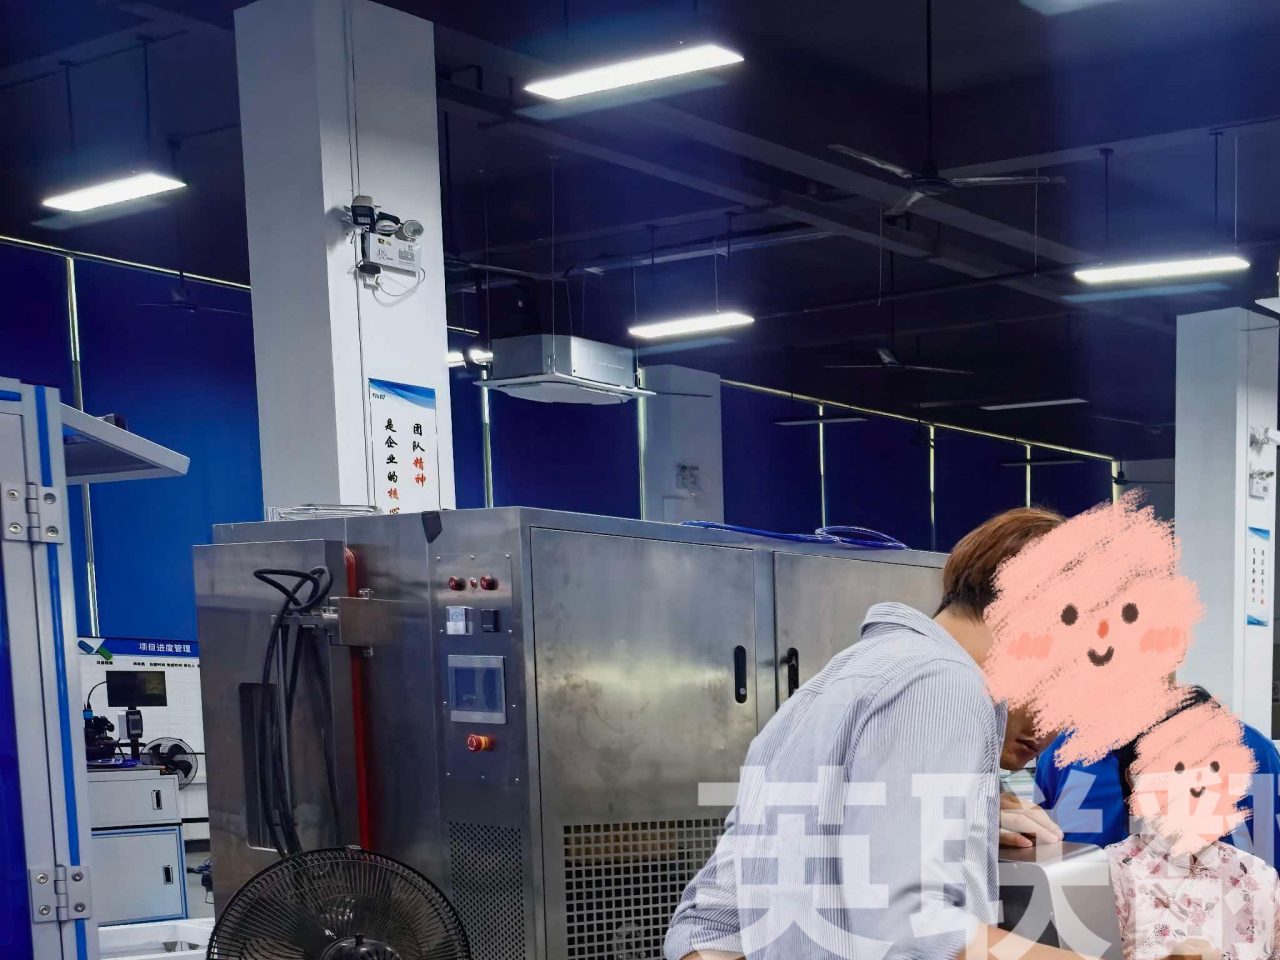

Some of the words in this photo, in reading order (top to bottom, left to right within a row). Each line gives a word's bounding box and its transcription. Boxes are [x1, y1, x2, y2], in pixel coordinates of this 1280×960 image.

[412, 423, 426, 488] 团队精神
[138, 642, 192, 653] 项目进度管理
